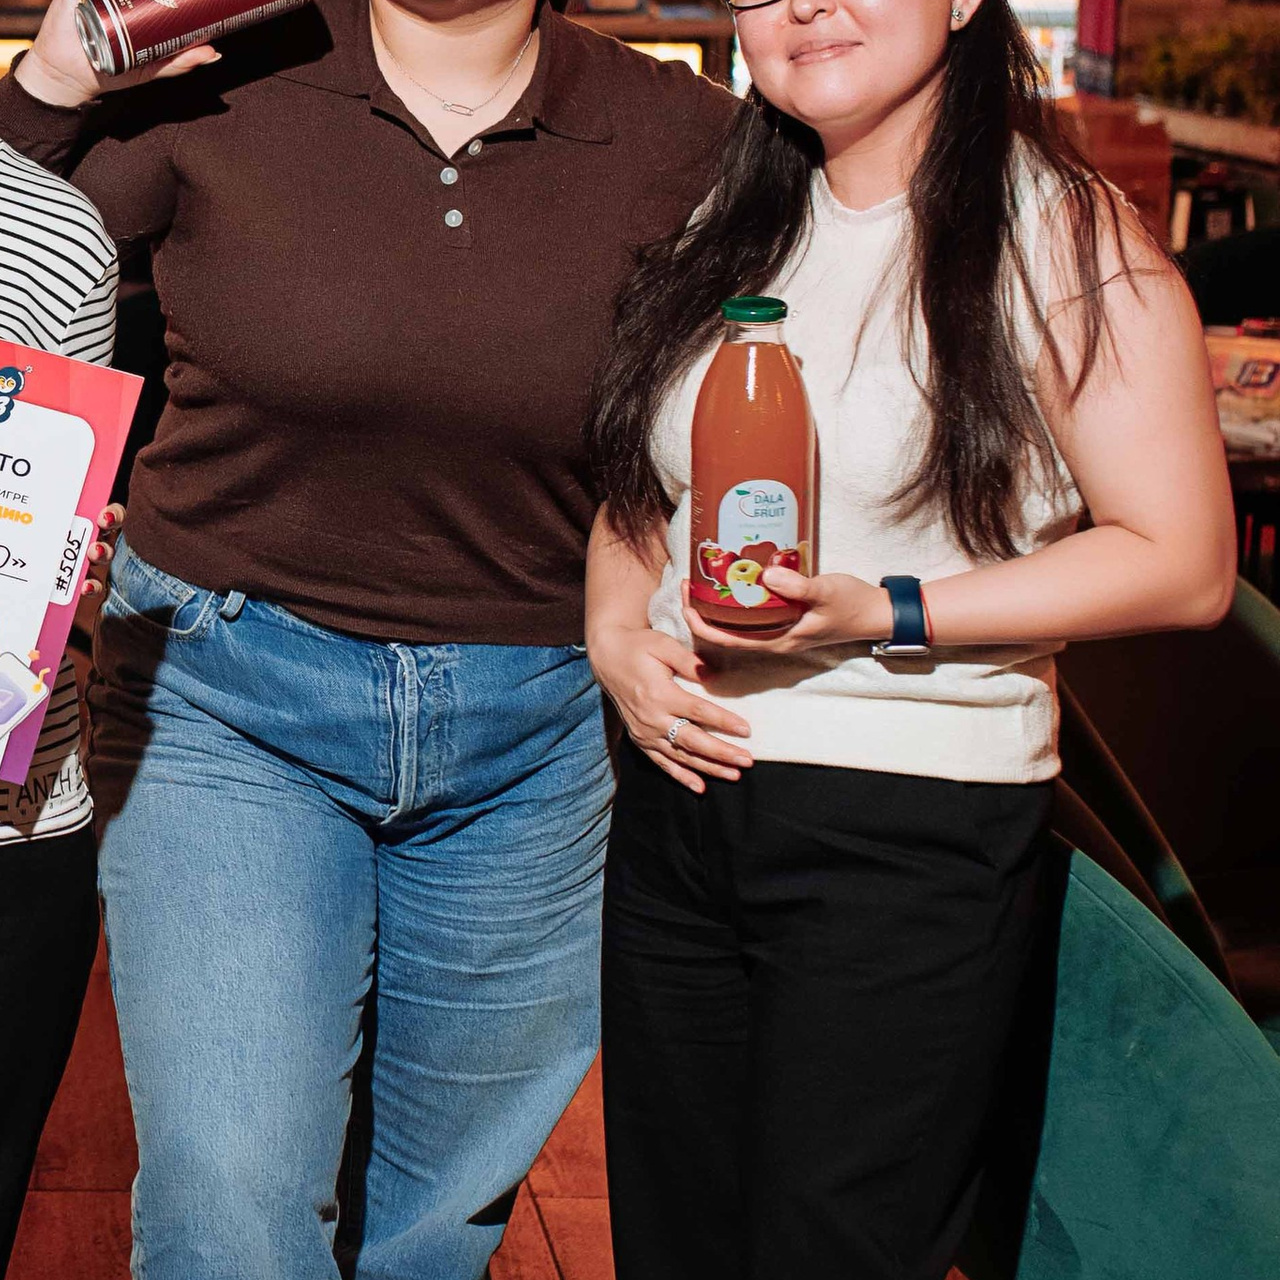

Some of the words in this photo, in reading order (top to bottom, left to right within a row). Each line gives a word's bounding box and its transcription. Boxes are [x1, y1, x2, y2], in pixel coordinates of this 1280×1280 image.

[754, 493, 784, 504] DALA
[754, 506, 787, 518] FRUIT
[55, 529, 82, 591] #505
